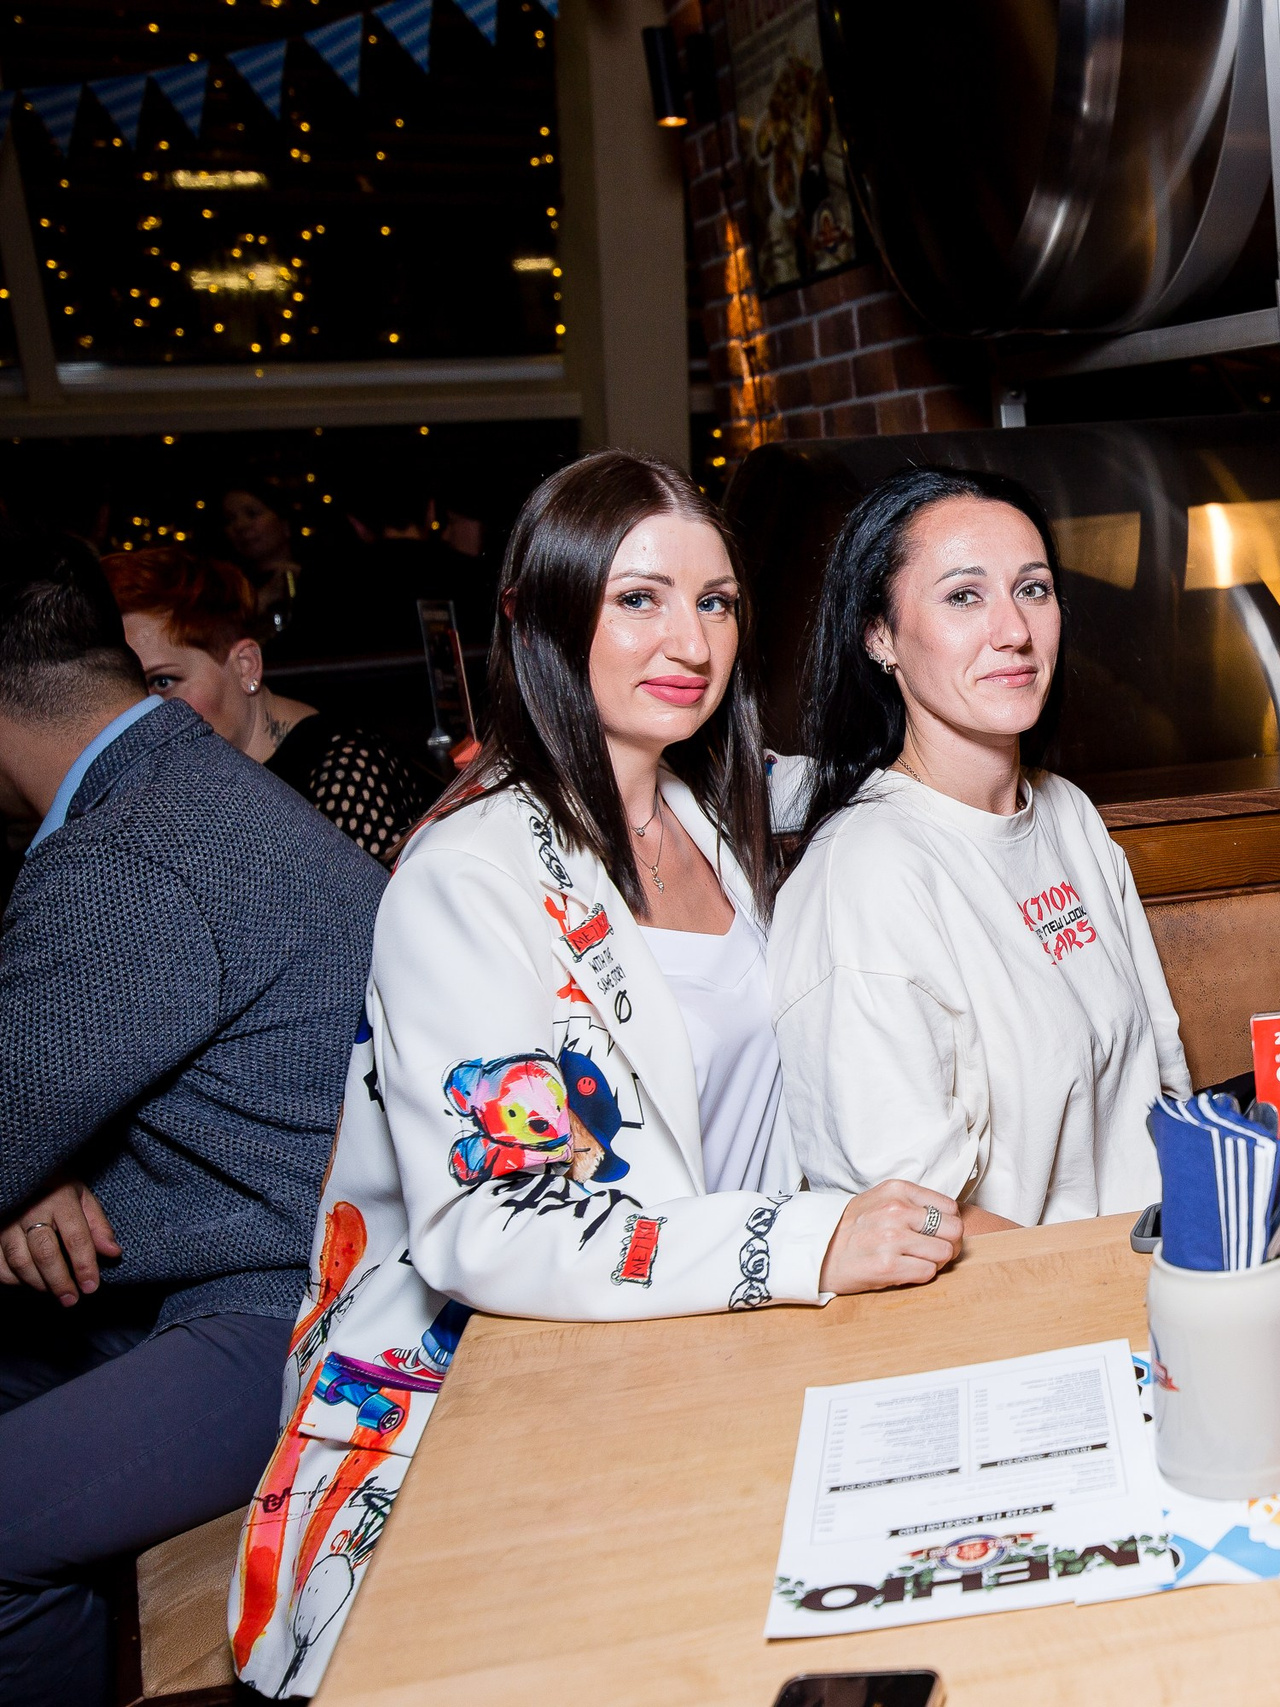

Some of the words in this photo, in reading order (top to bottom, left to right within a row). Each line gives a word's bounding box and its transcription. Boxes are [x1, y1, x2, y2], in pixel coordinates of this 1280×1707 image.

[1041, 917, 1065, 937] NEW
[1062, 905, 1087, 926] LOOK
[628, 1221, 656, 1278] METRO
[800, 1538, 1142, 1611] МЕНЮ
